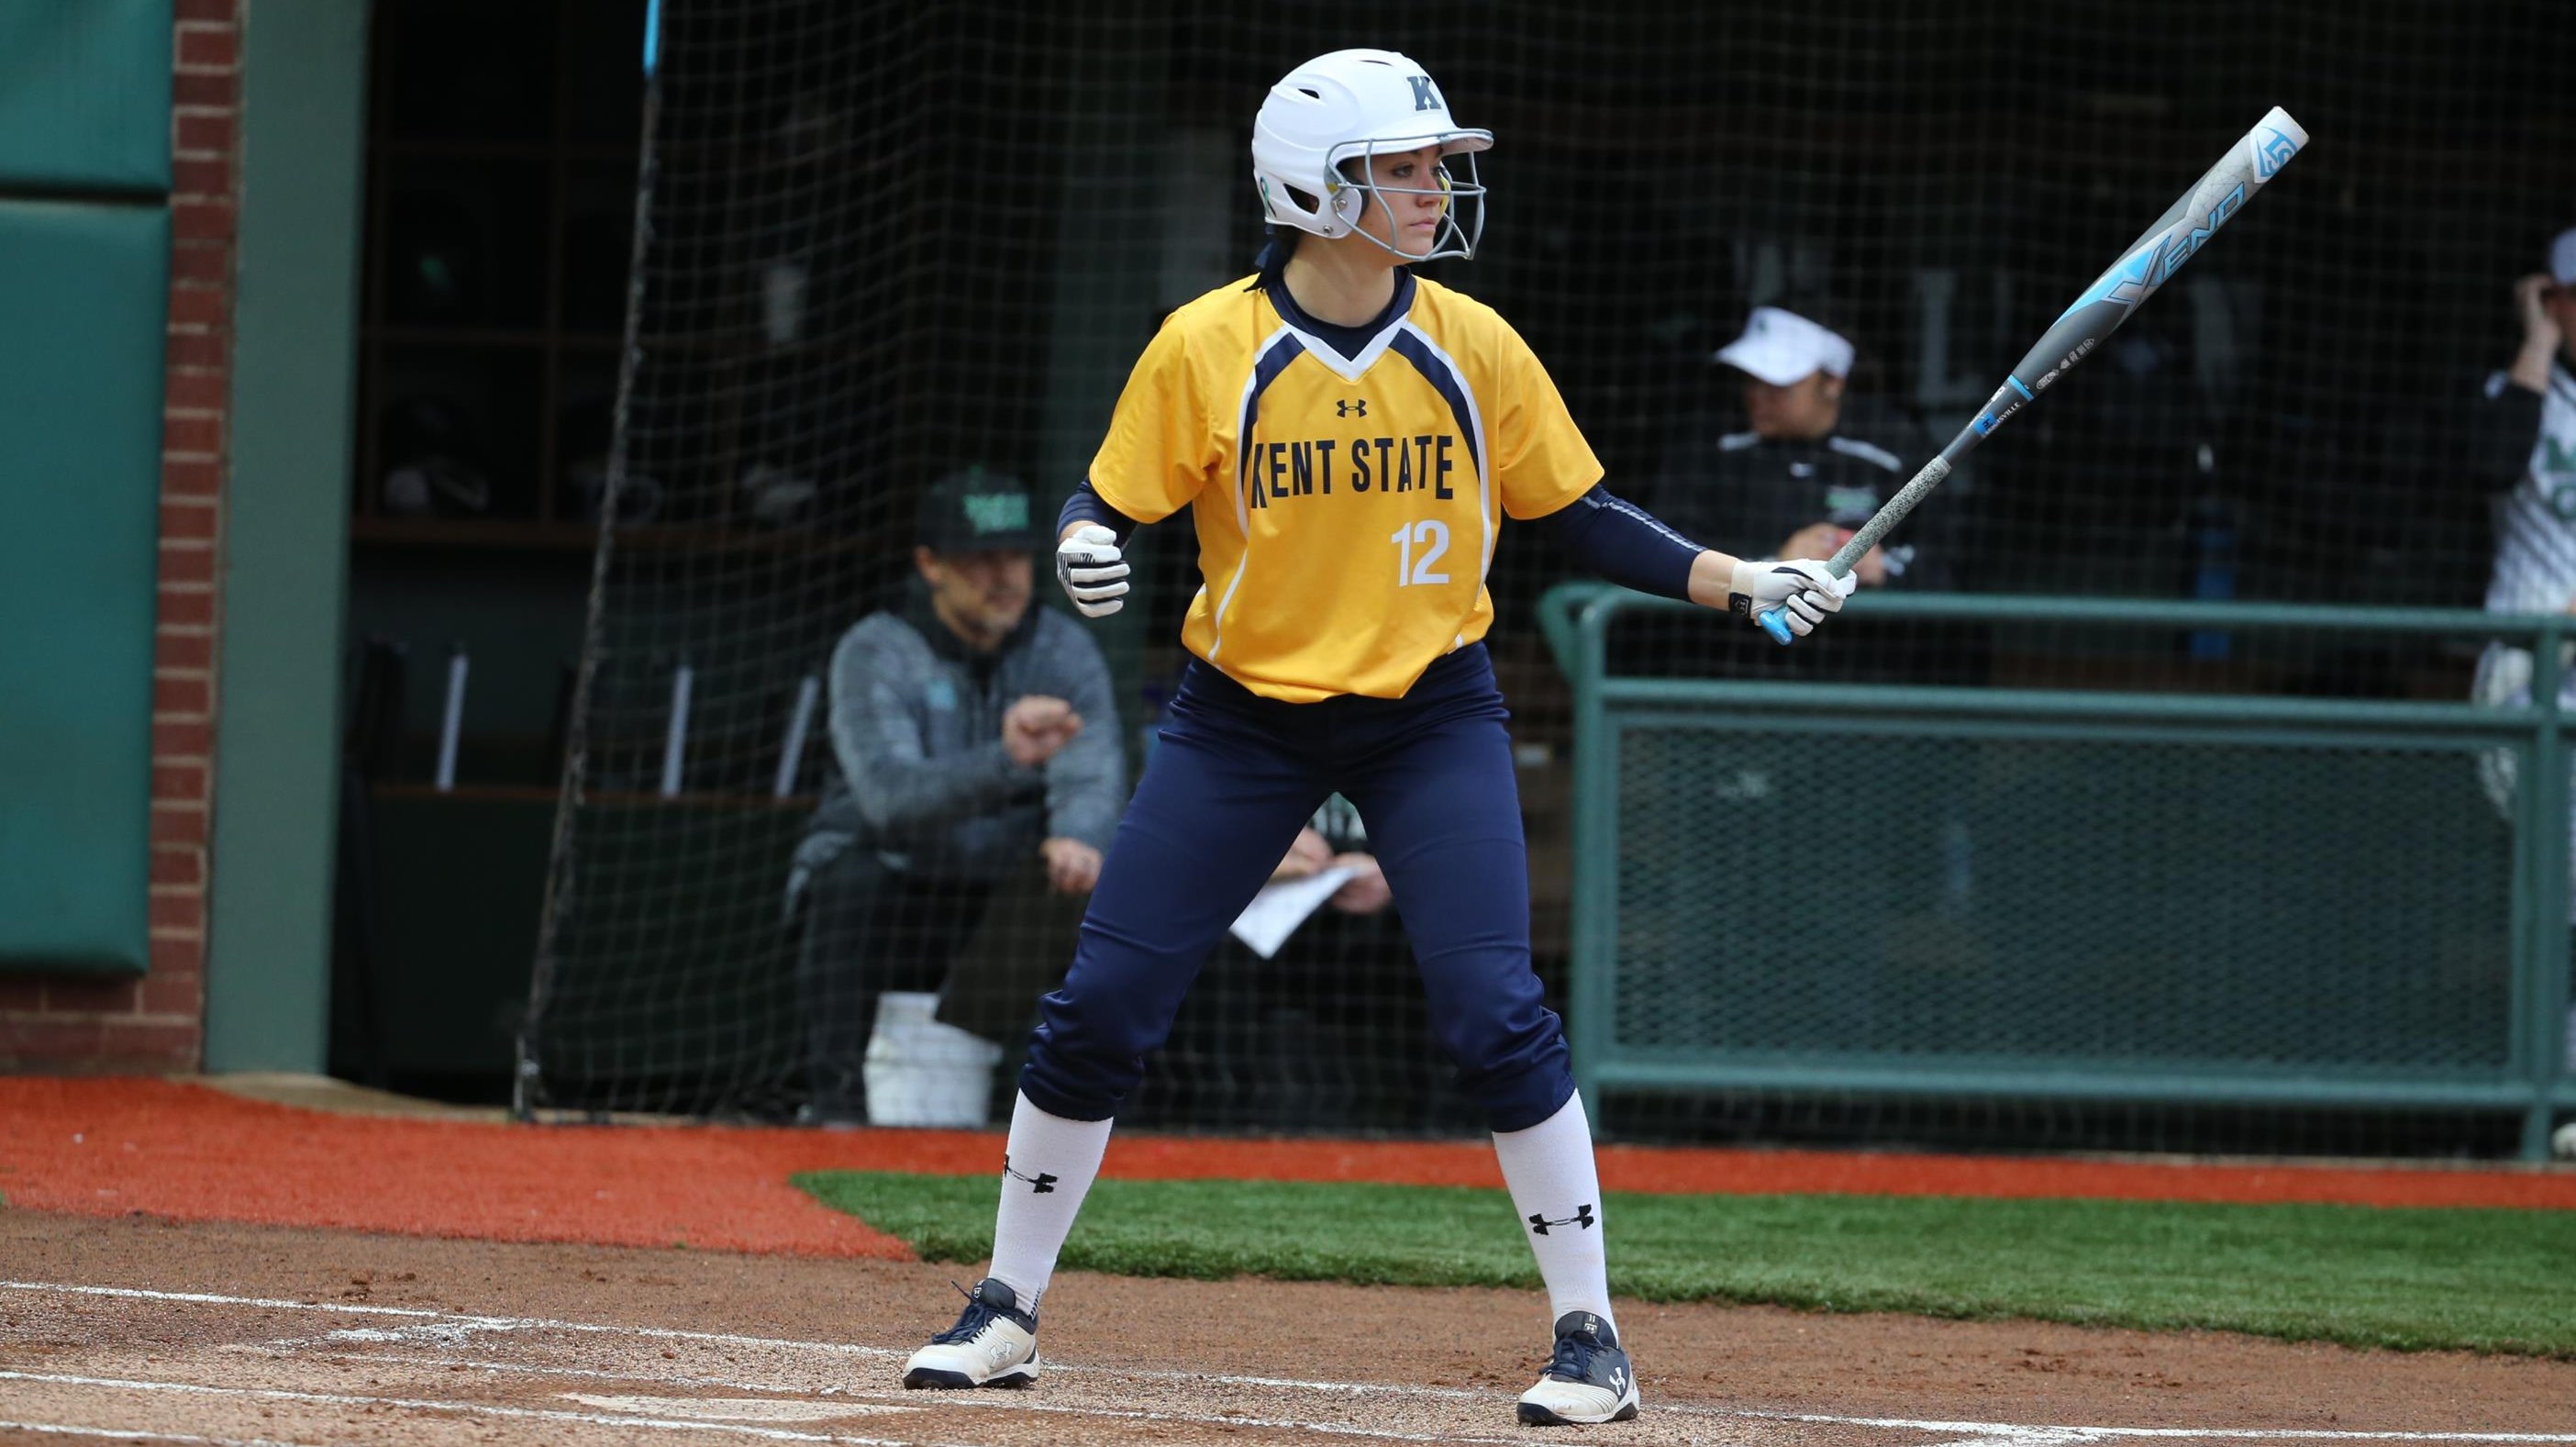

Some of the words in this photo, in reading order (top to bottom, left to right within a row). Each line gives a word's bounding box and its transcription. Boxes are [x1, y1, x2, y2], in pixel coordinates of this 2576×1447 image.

[1407, 75, 1442, 111] K
[1251, 440, 1335, 508] KENT
[1351, 435, 1453, 499] STATE
[1391, 519, 1449, 587] 12
